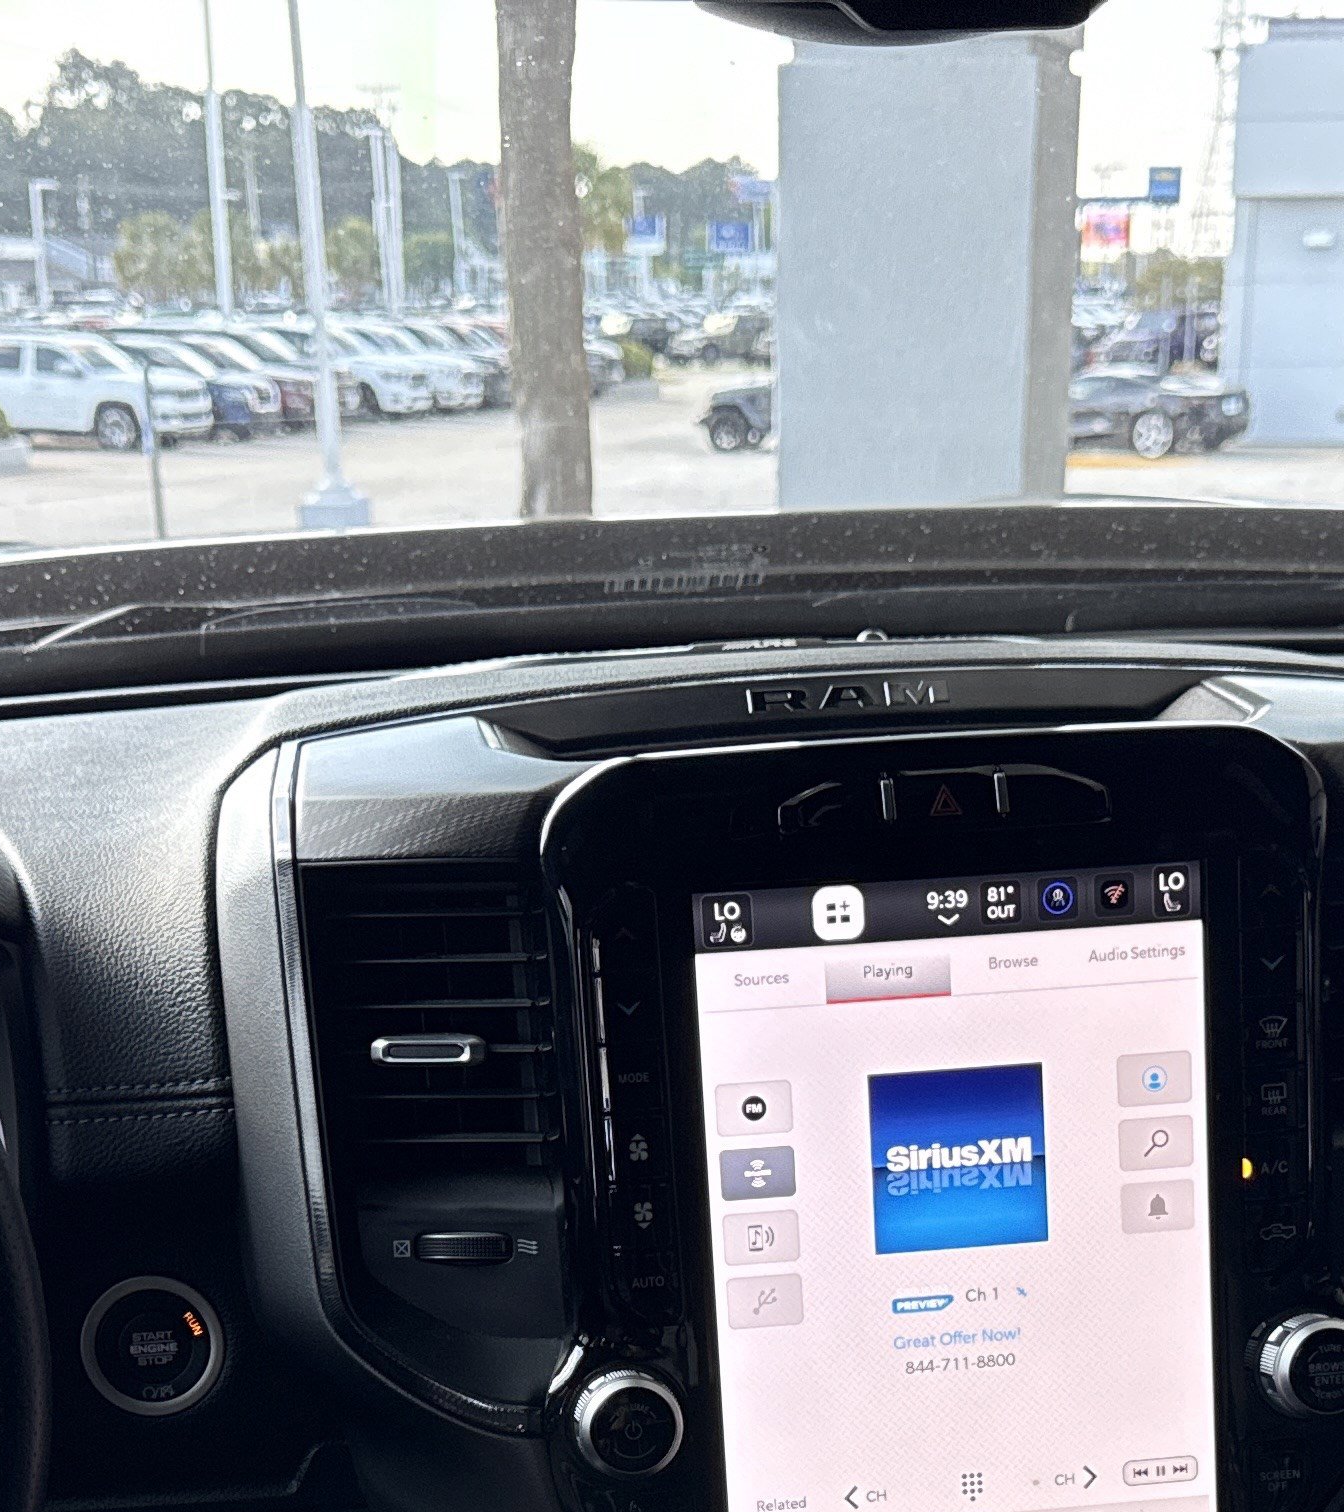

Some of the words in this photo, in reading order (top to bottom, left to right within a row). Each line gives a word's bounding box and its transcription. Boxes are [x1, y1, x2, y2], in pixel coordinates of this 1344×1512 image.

[747, 680, 948, 714] RAM
[1158, 871, 1185, 891] LO
[926, 889, 968, 910] 9:39
[714, 901, 741, 921] LO
[986, 904, 1016, 919] OUT
[1088, 947, 1128, 963] Audio
[1130, 943, 1186, 963] Settings
[988, 955, 1039, 970] Browse
[863, 963, 913, 980] Playing
[734, 973, 789, 987] Sources
[1256, 1037, 1288, 1050] FRONT
[618, 1072, 650, 1083] MODE
[745, 1102, 763, 1114] FM
[1261, 1105, 1287, 1116] REAR
[886, 1136, 1033, 1172] SiriusXM
[1260, 1160, 1289, 1174] A/C
[632, 1275, 665, 1289] AUTO
[965, 1287, 986, 1302] Ch
[992, 1286, 999, 1300] 1
[896, 1297, 950, 1311] PREVIEW
[182, 1311, 204, 1338] RUN
[132, 1330, 173, 1342] START
[893, 1334, 936, 1350] Great
[940, 1330, 978, 1346] Offer
[982, 1326, 1022, 1343] Now!
[129, 1341, 179, 1355] ENGINE
[1318, 1343, 1344, 1354] TUNE
[137, 1354, 174, 1366] STOP
[905, 1352, 1016, 1375] 844-711-8800
[1054, 1473, 1076, 1487] CH
[1259, 1469, 1301, 1481] SCREEN
[1267, 1481, 1288, 1492] OFF
[866, 1489, 888, 1503] CH
[756, 1496, 807, 1512] Related
